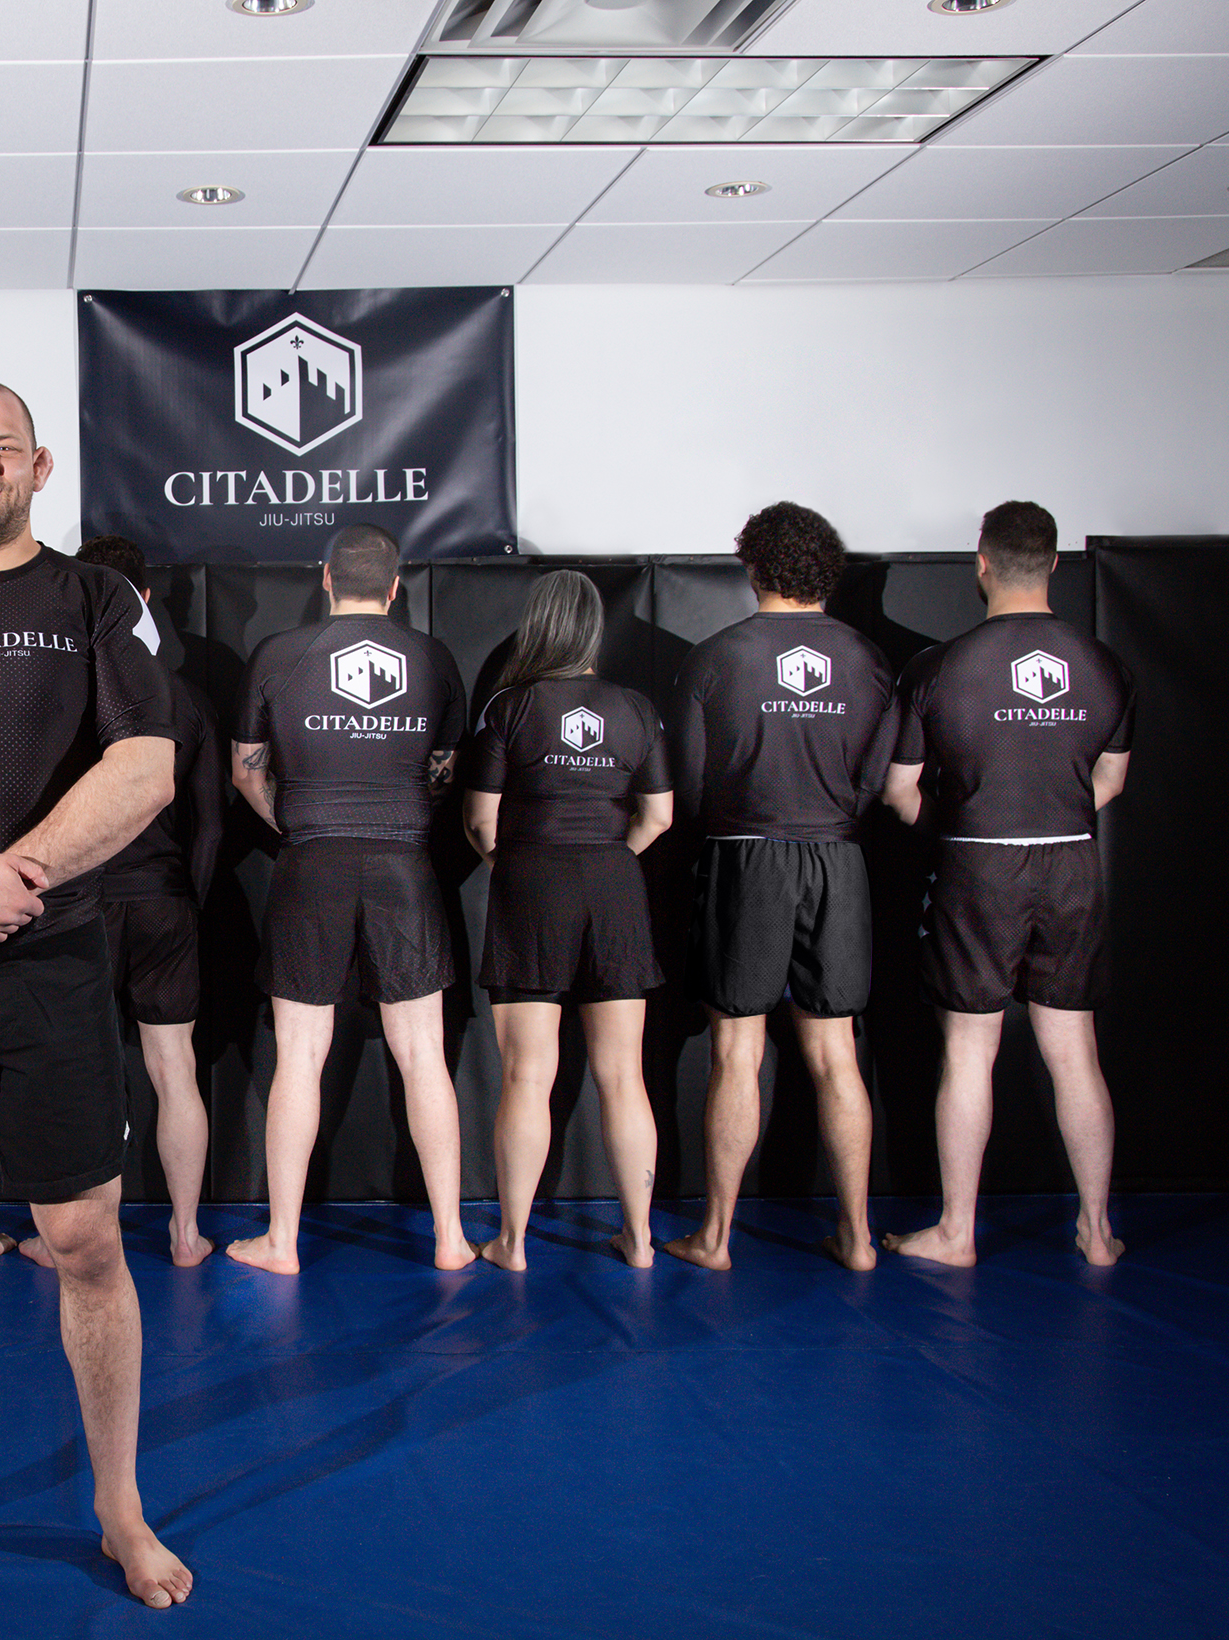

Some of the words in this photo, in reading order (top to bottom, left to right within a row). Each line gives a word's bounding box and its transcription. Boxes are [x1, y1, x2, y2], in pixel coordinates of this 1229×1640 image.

[164, 468, 429, 507] CITADELLE
[259, 513, 335, 526] JIU-JITSU
[760, 700, 846, 715] CITADELLE
[994, 708, 1087, 722] CITADELLE
[304, 714, 428, 732] CITADELLE
[349, 732, 387, 740] JIU-JITSU
[544, 754, 616, 768] CITADELLE
